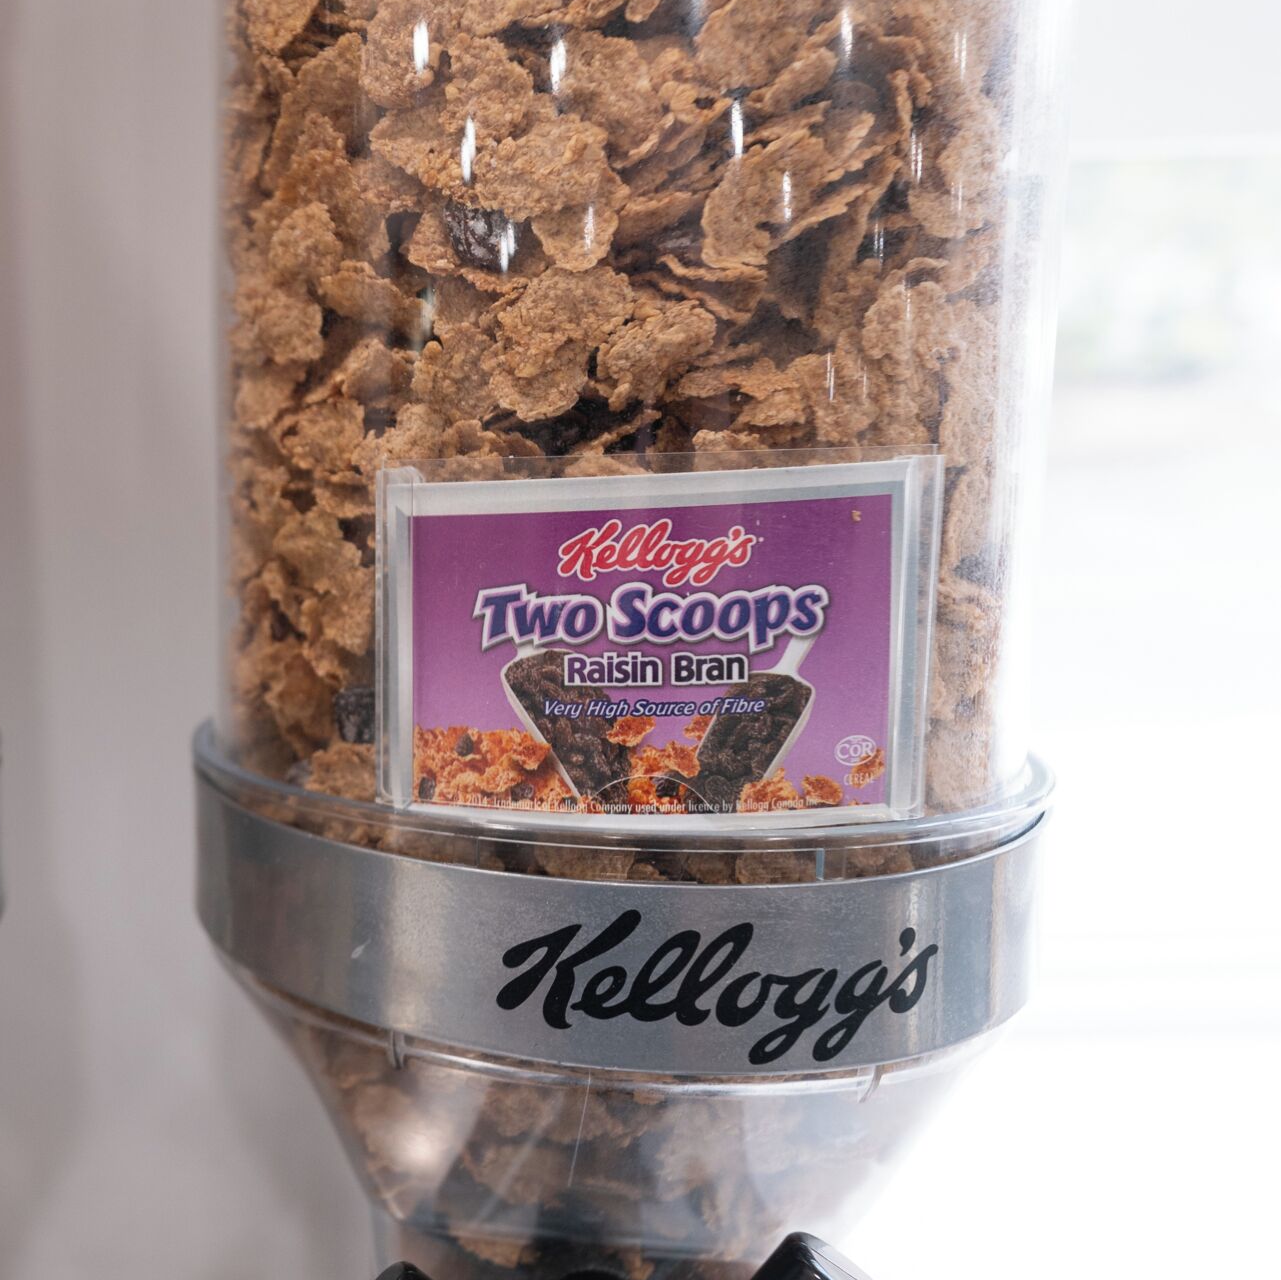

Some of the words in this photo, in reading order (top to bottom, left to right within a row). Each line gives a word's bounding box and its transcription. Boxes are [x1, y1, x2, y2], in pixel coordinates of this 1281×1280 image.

[559, 519, 756, 587] Kellogg's
[476, 586, 601, 647] Two
[609, 584, 827, 651] Scoops
[566, 654, 661, 685] Raisin
[673, 654, 747, 685] Bran
[544, 700, 583, 718] Very
[587, 701, 628, 718] High
[633, 700, 696, 717] Source
[699, 699, 720, 716] of
[721, 698, 765, 715] Fibre
[837, 742, 873, 759] COR
[554, 797, 588, 814] Kellogg
[590, 799, 632, 814] Company
[635, 799, 657, 813] used
[659, 800, 686, 813] under
[688, 799, 720, 813] licence
[722, 799, 734, 813] by
[736, 798, 769, 813] Kellogg
[496, 909, 939, 1065] Kellogg's
